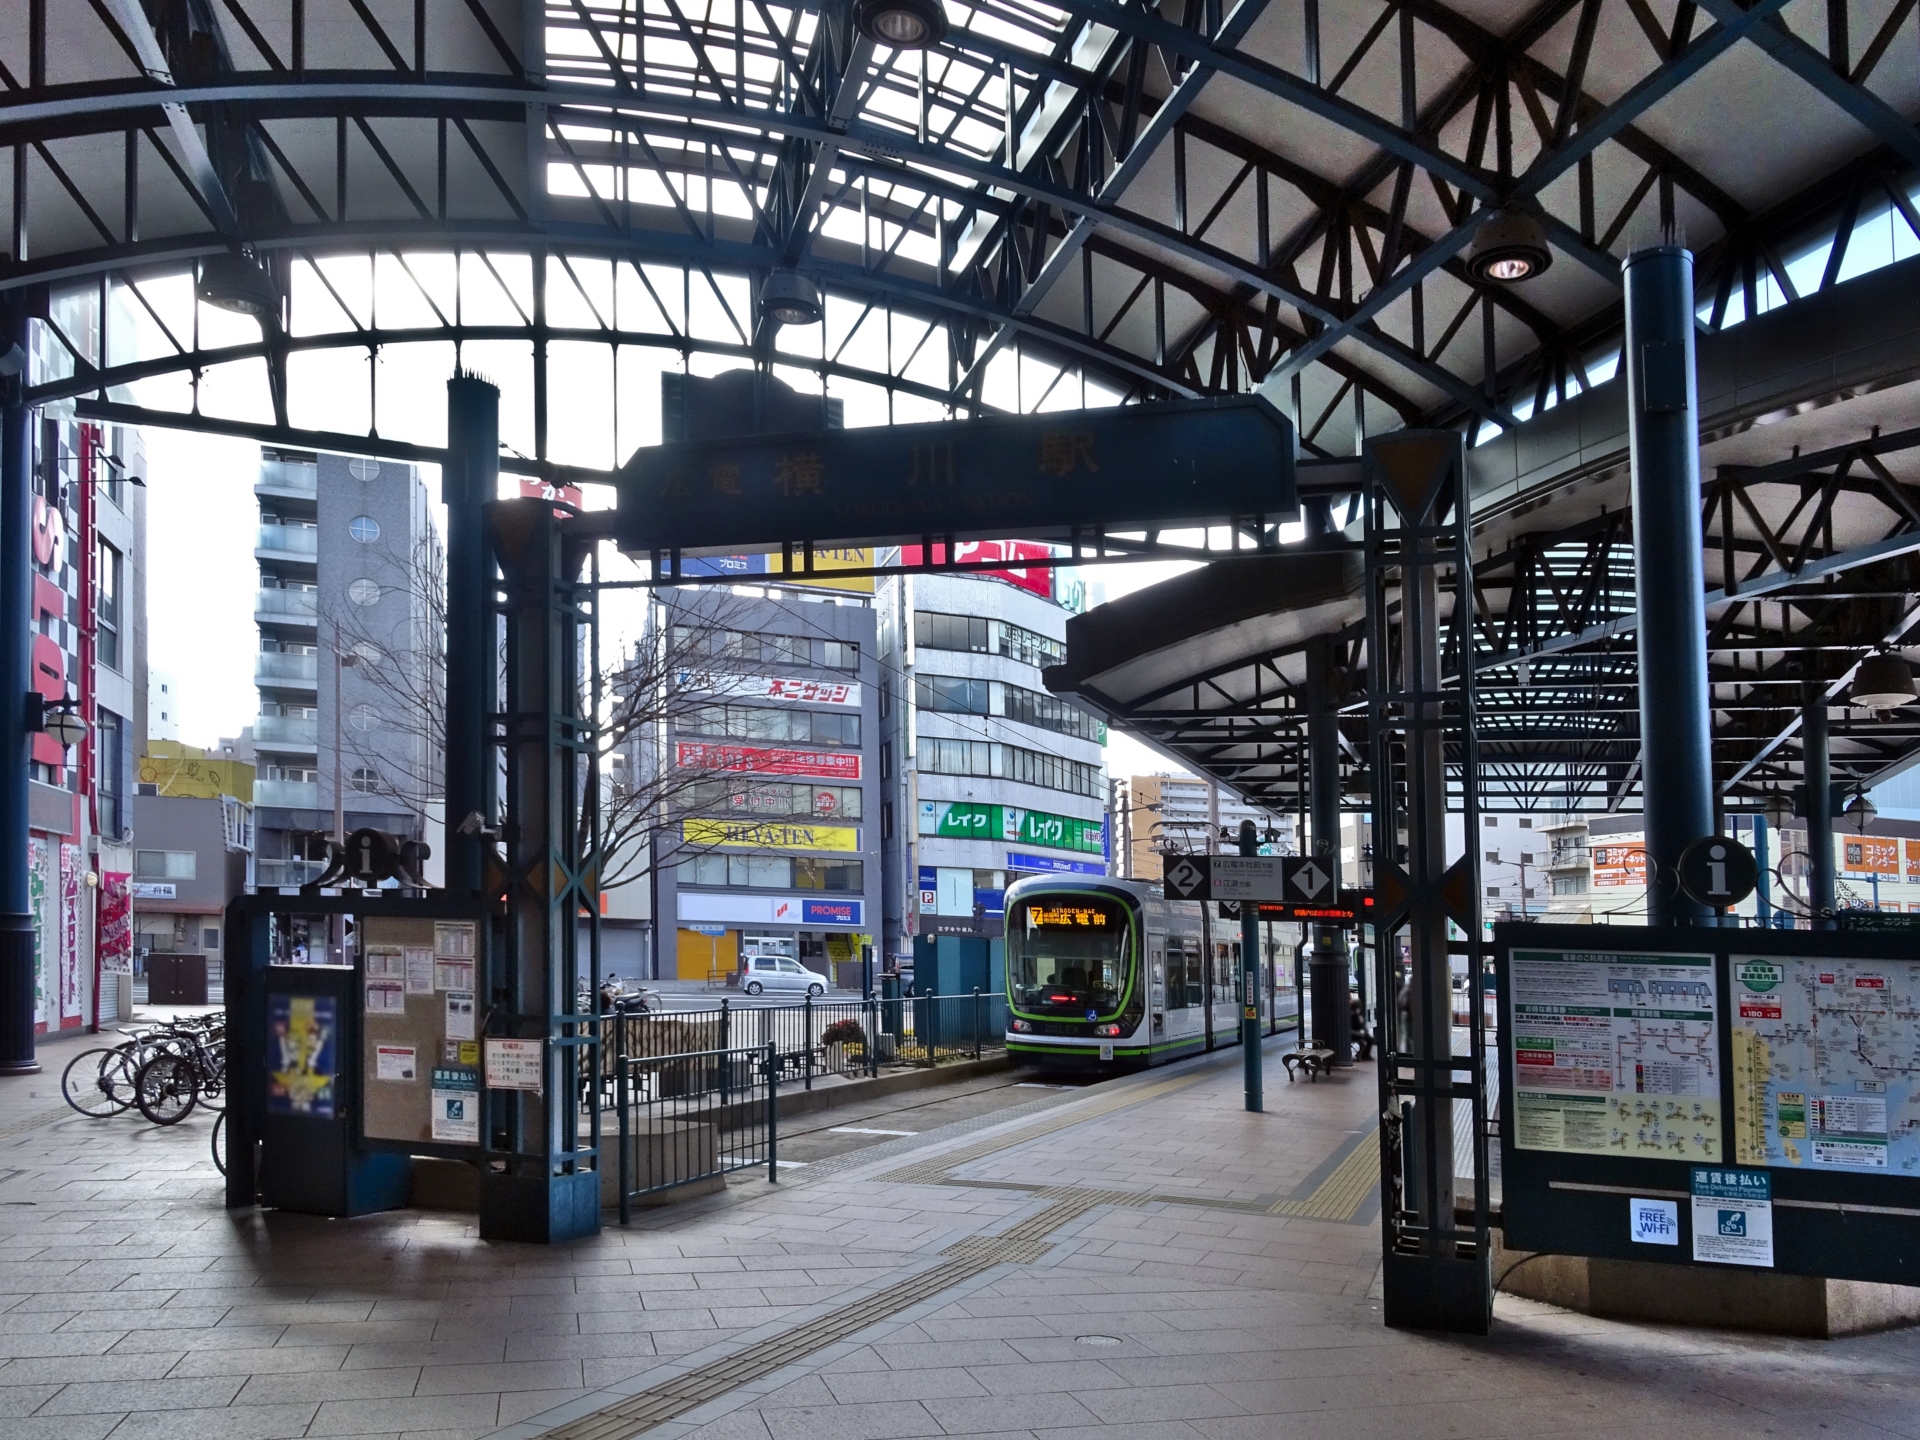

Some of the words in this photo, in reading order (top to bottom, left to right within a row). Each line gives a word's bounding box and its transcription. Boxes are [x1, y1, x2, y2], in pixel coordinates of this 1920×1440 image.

[719, 558, 749, 571] プロミス
[733, 795, 789, 809] 受付中!!
[948, 812, 987, 828] レイク
[1030, 816, 1062, 841] レイク
[1606, 848, 1628, 857] コミック
[1865, 844, 1897, 856] コミック
[1607, 854, 1646, 865] インターネット
[1866, 856, 1898, 867] インター
[1177, 865, 1194, 887] 2
[1303, 870, 1314, 890] 1
[1223, 879, 1252, 888] 江波方面
[811, 905, 851, 916] PROMISE
[1060, 912, 1107, 925] 広電前
[1562, 953, 1619, 964] 電車のご利用方法
[1695, 1170, 1767, 1188] 運賃後払い
[1695, 1182, 1709, 1191] Fare
[1711, 1183, 1738, 1193] Deferred
[1739, 1186, 1767, 1196] Payment
[1639, 1212, 1666, 1223] FREE
